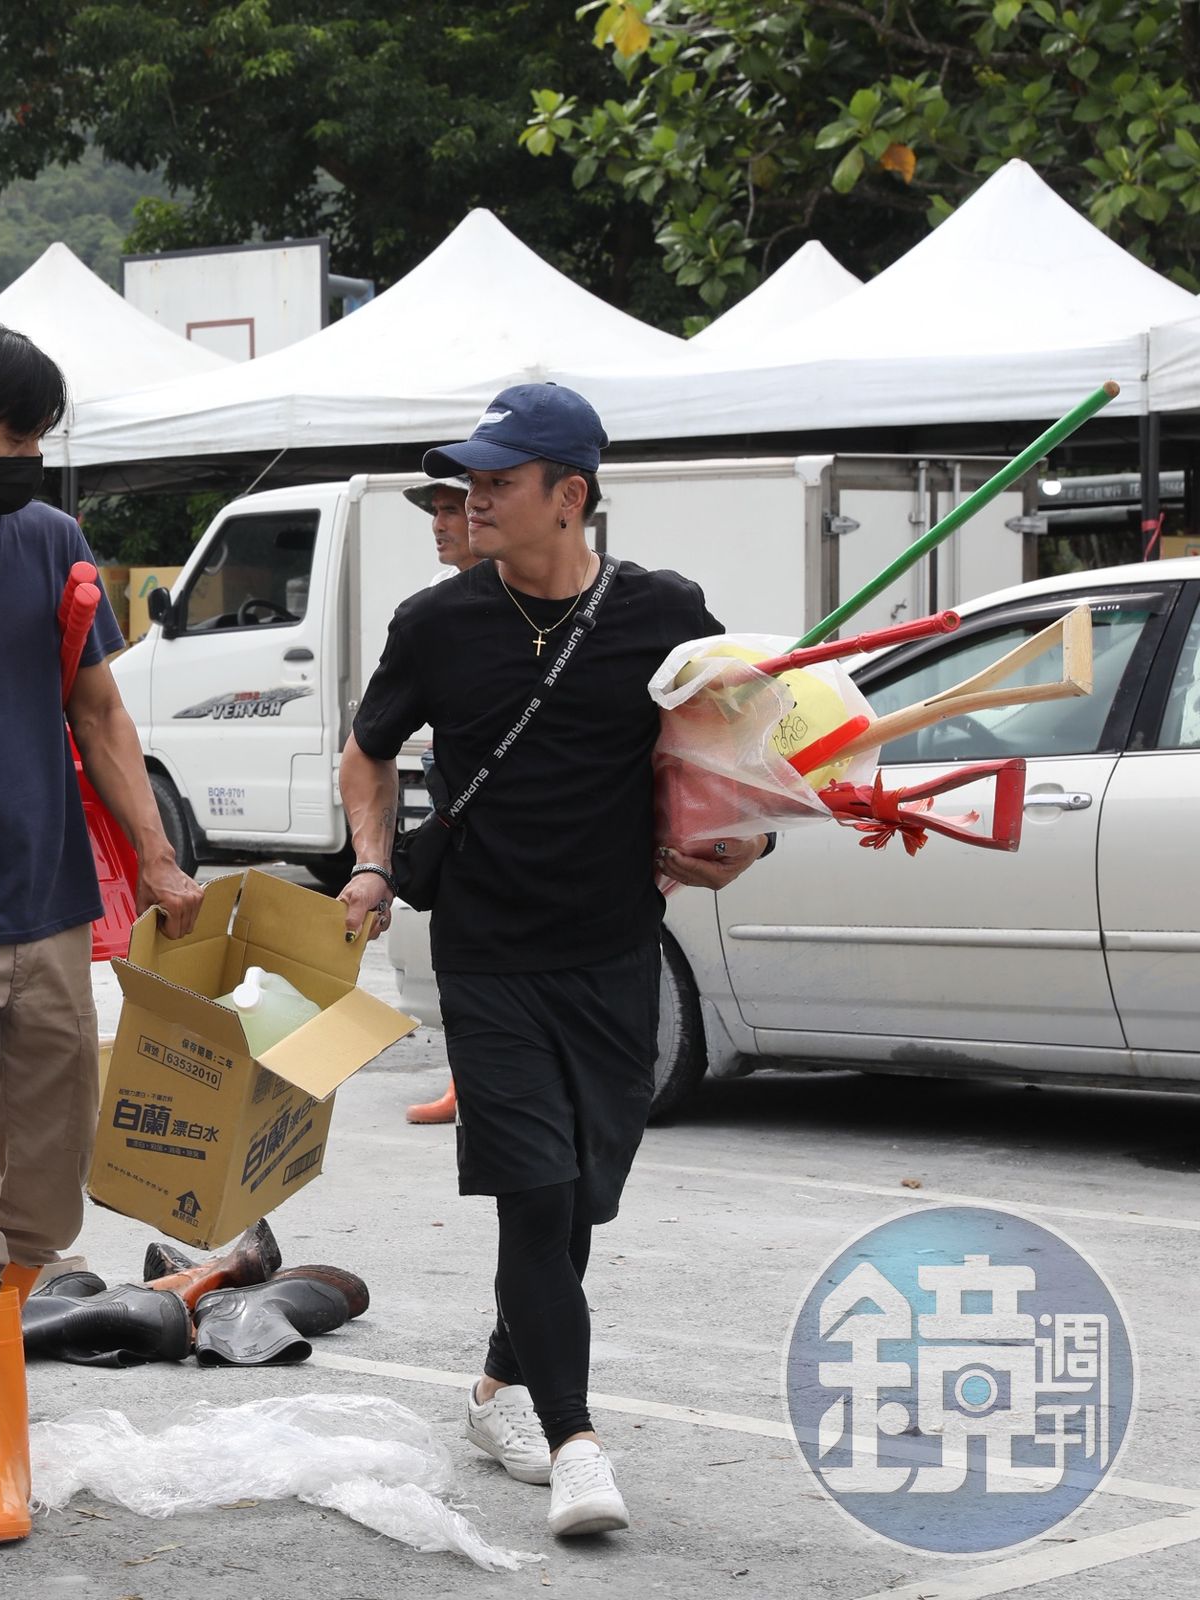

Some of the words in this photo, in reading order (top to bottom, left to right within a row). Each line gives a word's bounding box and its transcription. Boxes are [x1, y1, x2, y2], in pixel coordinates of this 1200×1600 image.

[583, 563, 615, 618] SUPREME
[493, 697, 541, 759] SUPREME
[208, 787, 246, 799] BQR-9701
[449, 767, 489, 818] SUPREM
[166, 1053, 218, 1085] 63532010
[113, 1099, 173, 1137] 白蘭
[171, 1119, 220, 1143] 漂白水
